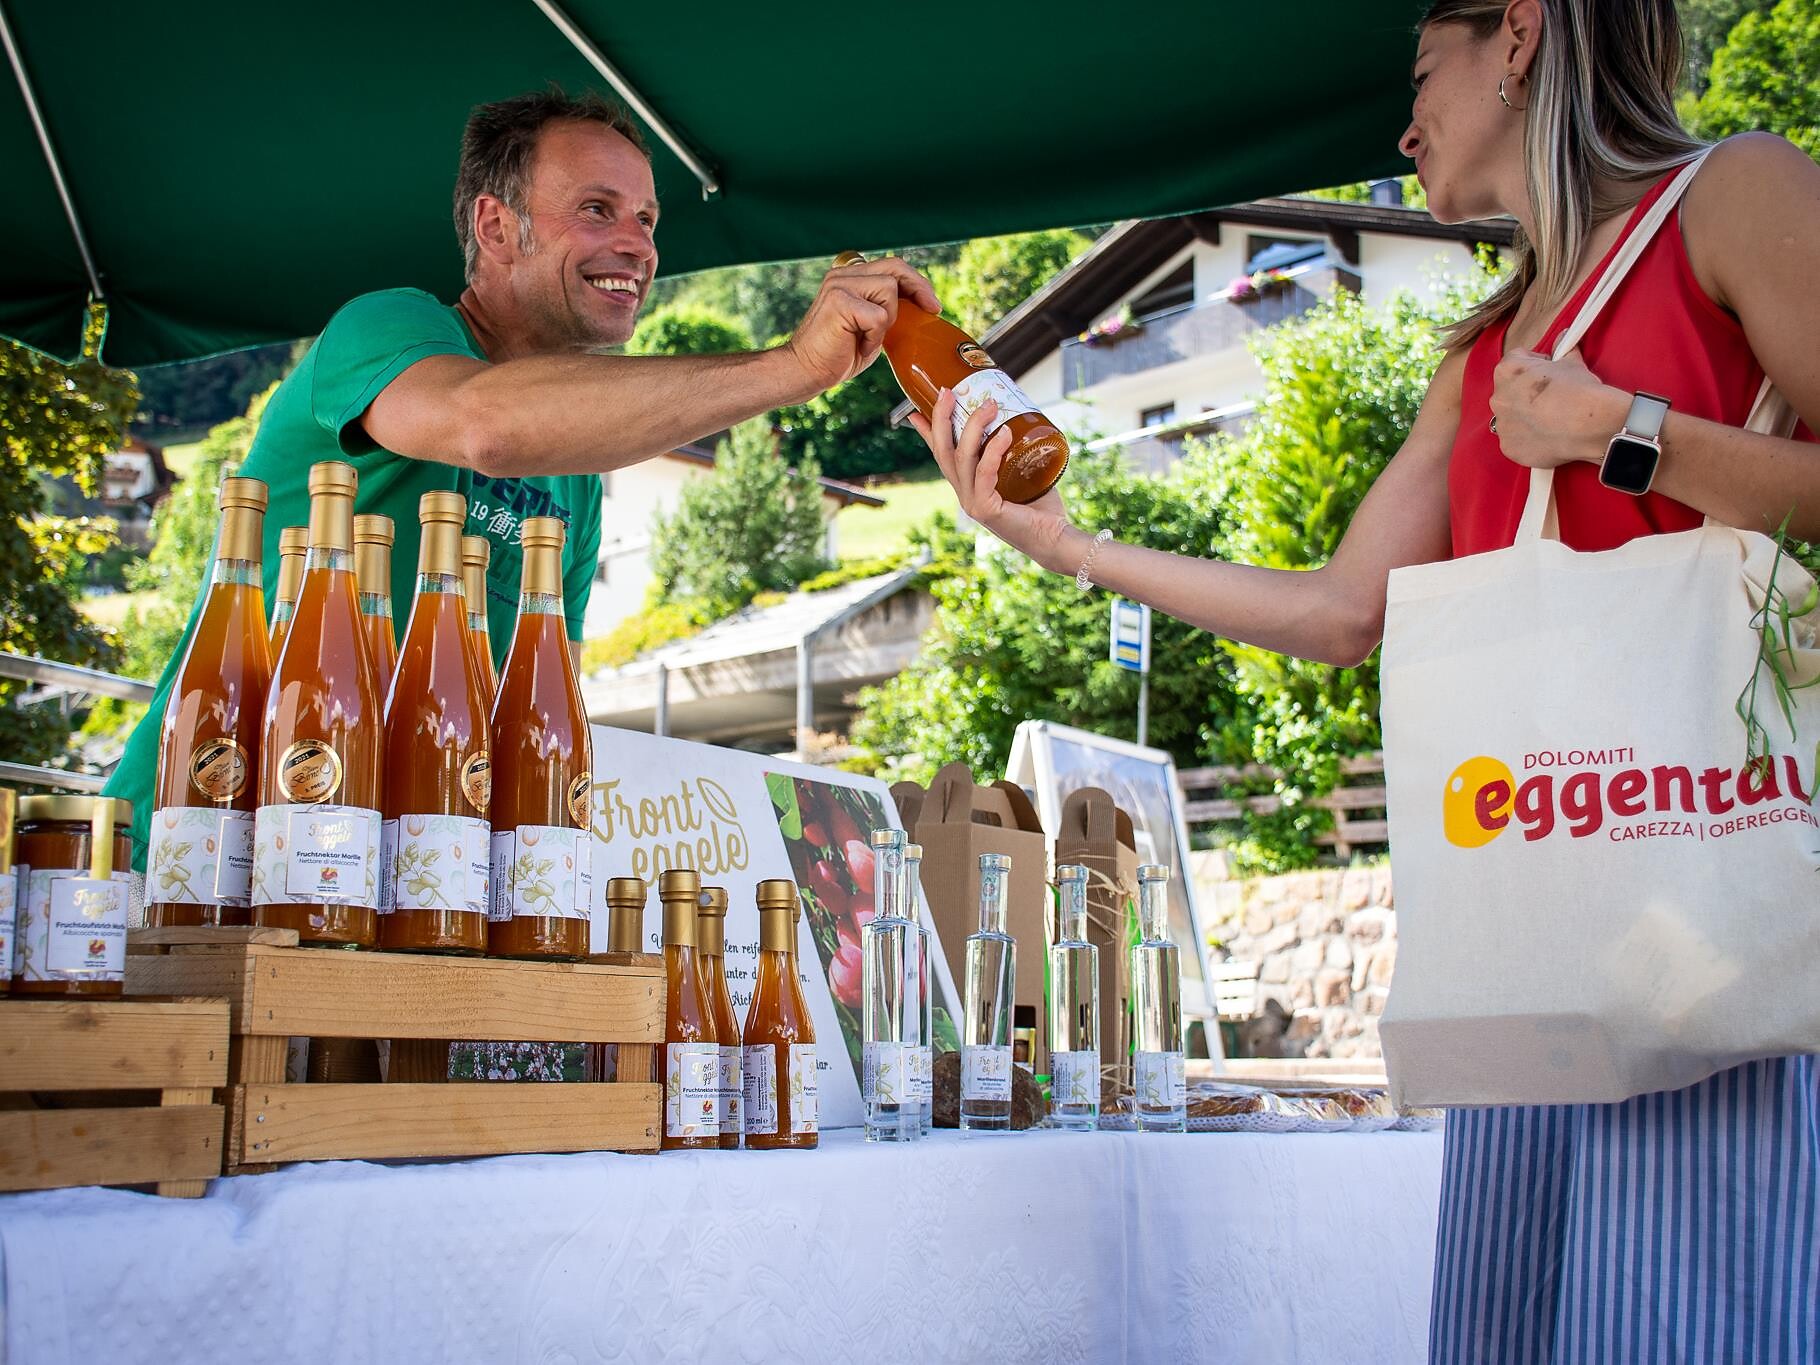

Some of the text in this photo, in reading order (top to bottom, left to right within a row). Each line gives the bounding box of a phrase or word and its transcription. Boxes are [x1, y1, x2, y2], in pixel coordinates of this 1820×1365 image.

[470, 500, 489, 521] 19
[1523, 747, 1634, 769] DOLOMITI
[1474, 755, 1812, 842] eggental
[593, 778, 702, 844] Front
[1609, 822, 1694, 842] CAREZZA
